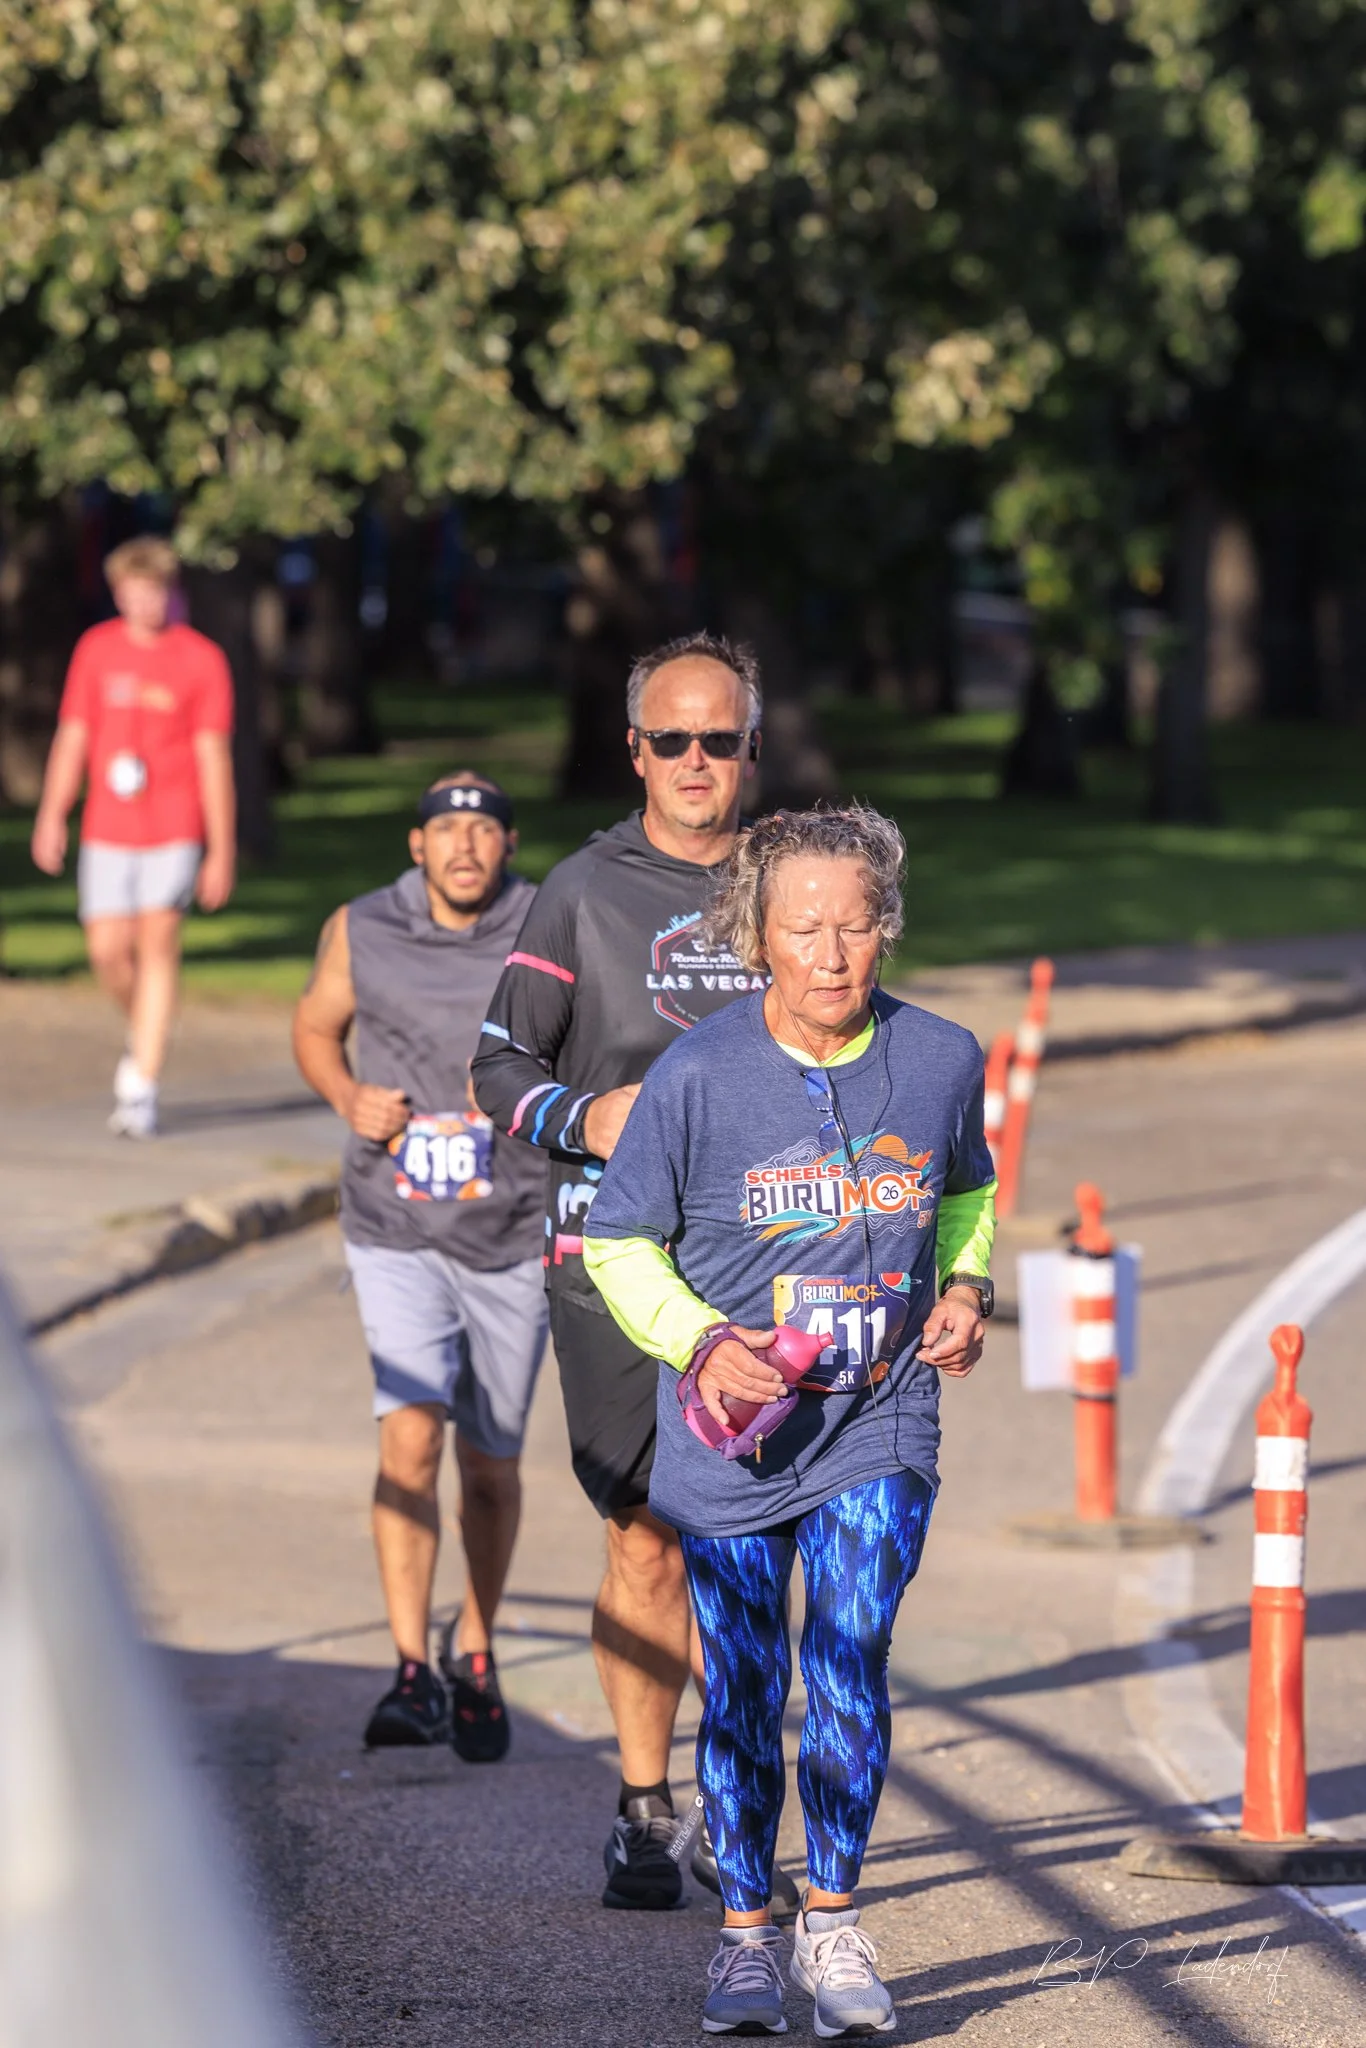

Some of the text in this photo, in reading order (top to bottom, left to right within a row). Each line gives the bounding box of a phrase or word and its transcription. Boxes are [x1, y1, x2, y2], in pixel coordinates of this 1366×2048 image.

[670, 952, 709, 964] Rock
[646, 973, 693, 990] LAS
[404, 1134, 477, 1182] 416
[745, 1164, 844, 1185] SCHEELS
[880, 1185, 899, 1200] 26
[806, 1306, 887, 1365] 411
[839, 1371, 855, 1385] 5K
